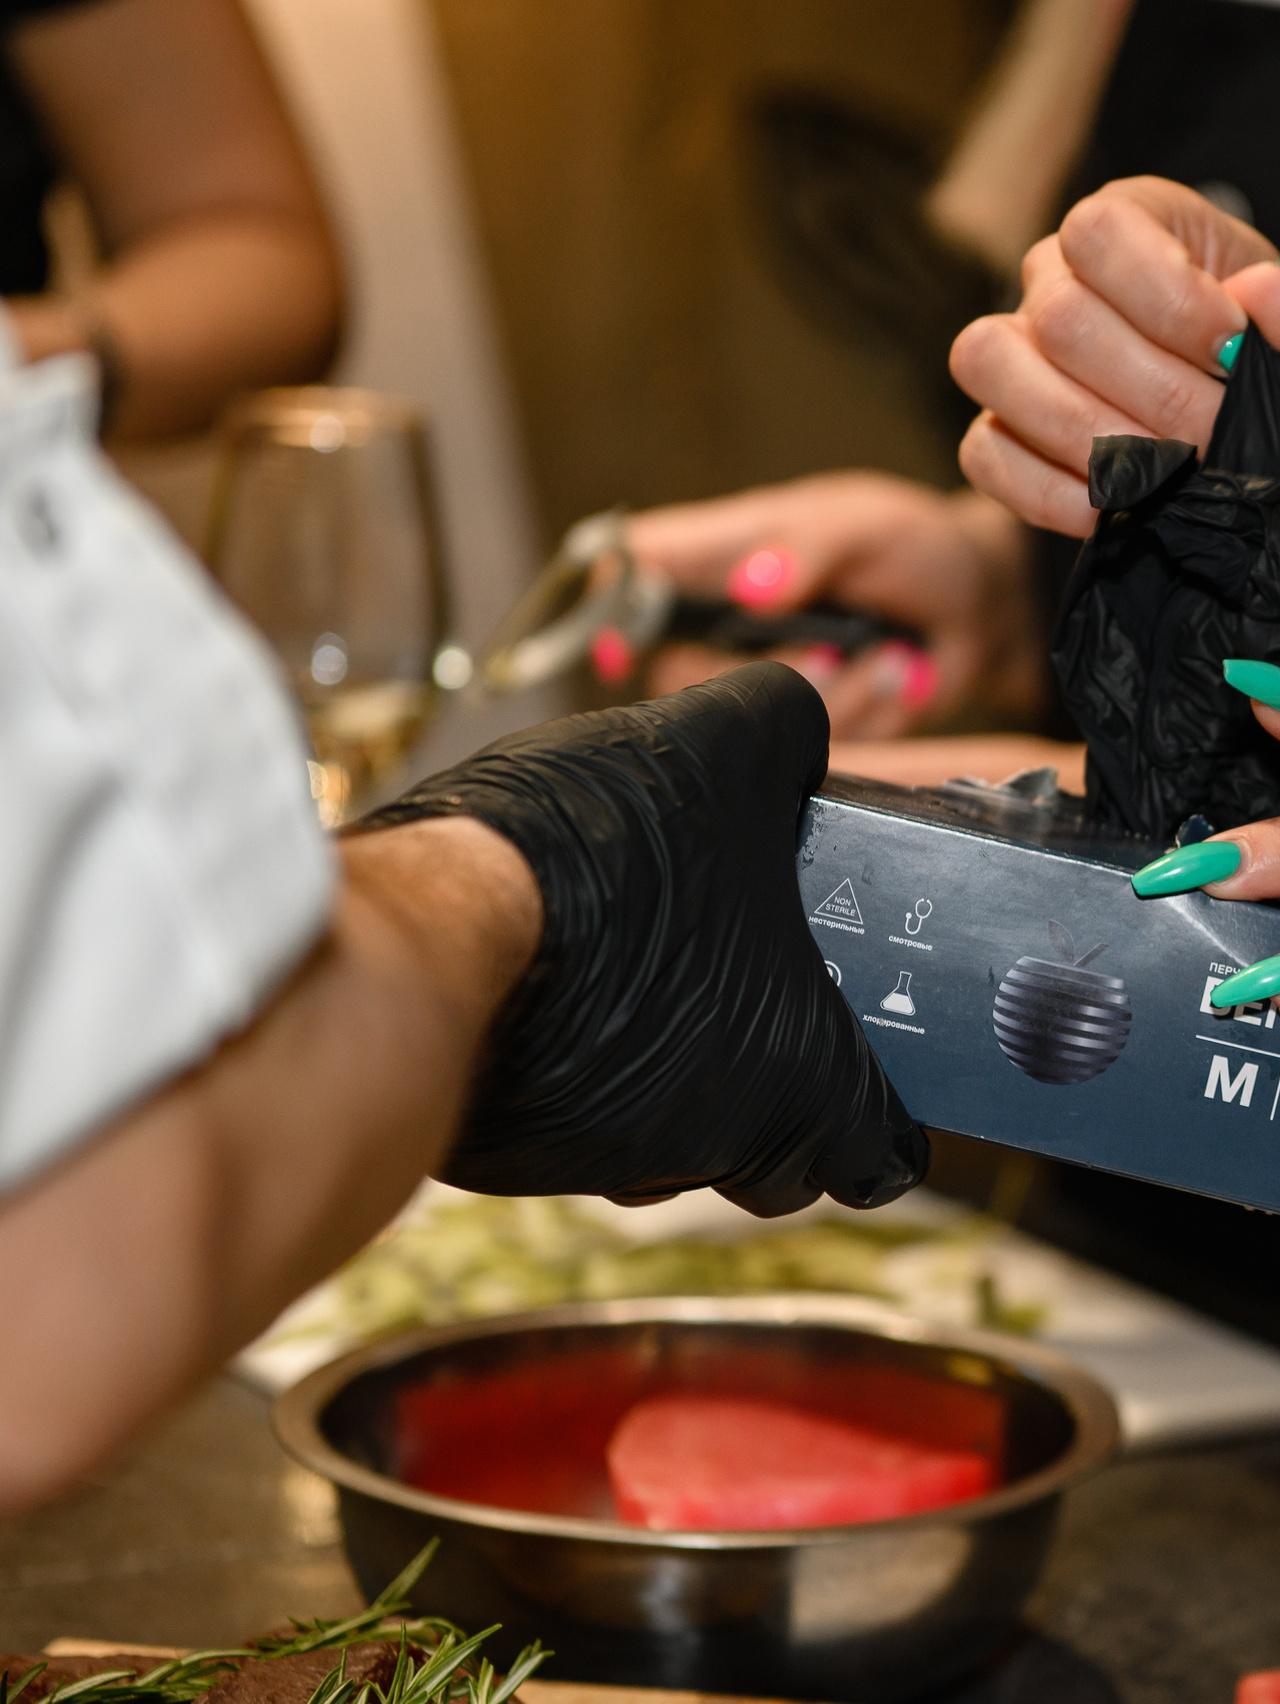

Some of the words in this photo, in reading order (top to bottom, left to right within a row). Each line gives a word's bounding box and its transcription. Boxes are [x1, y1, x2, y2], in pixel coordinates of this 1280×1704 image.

[834, 896, 851, 906] NON
[825, 903, 856, 917] STERILE
[808, 915, 865, 935] нестерильные
[888, 935, 933, 951] смотровые
[1204, 1055, 1259, 1107] M
